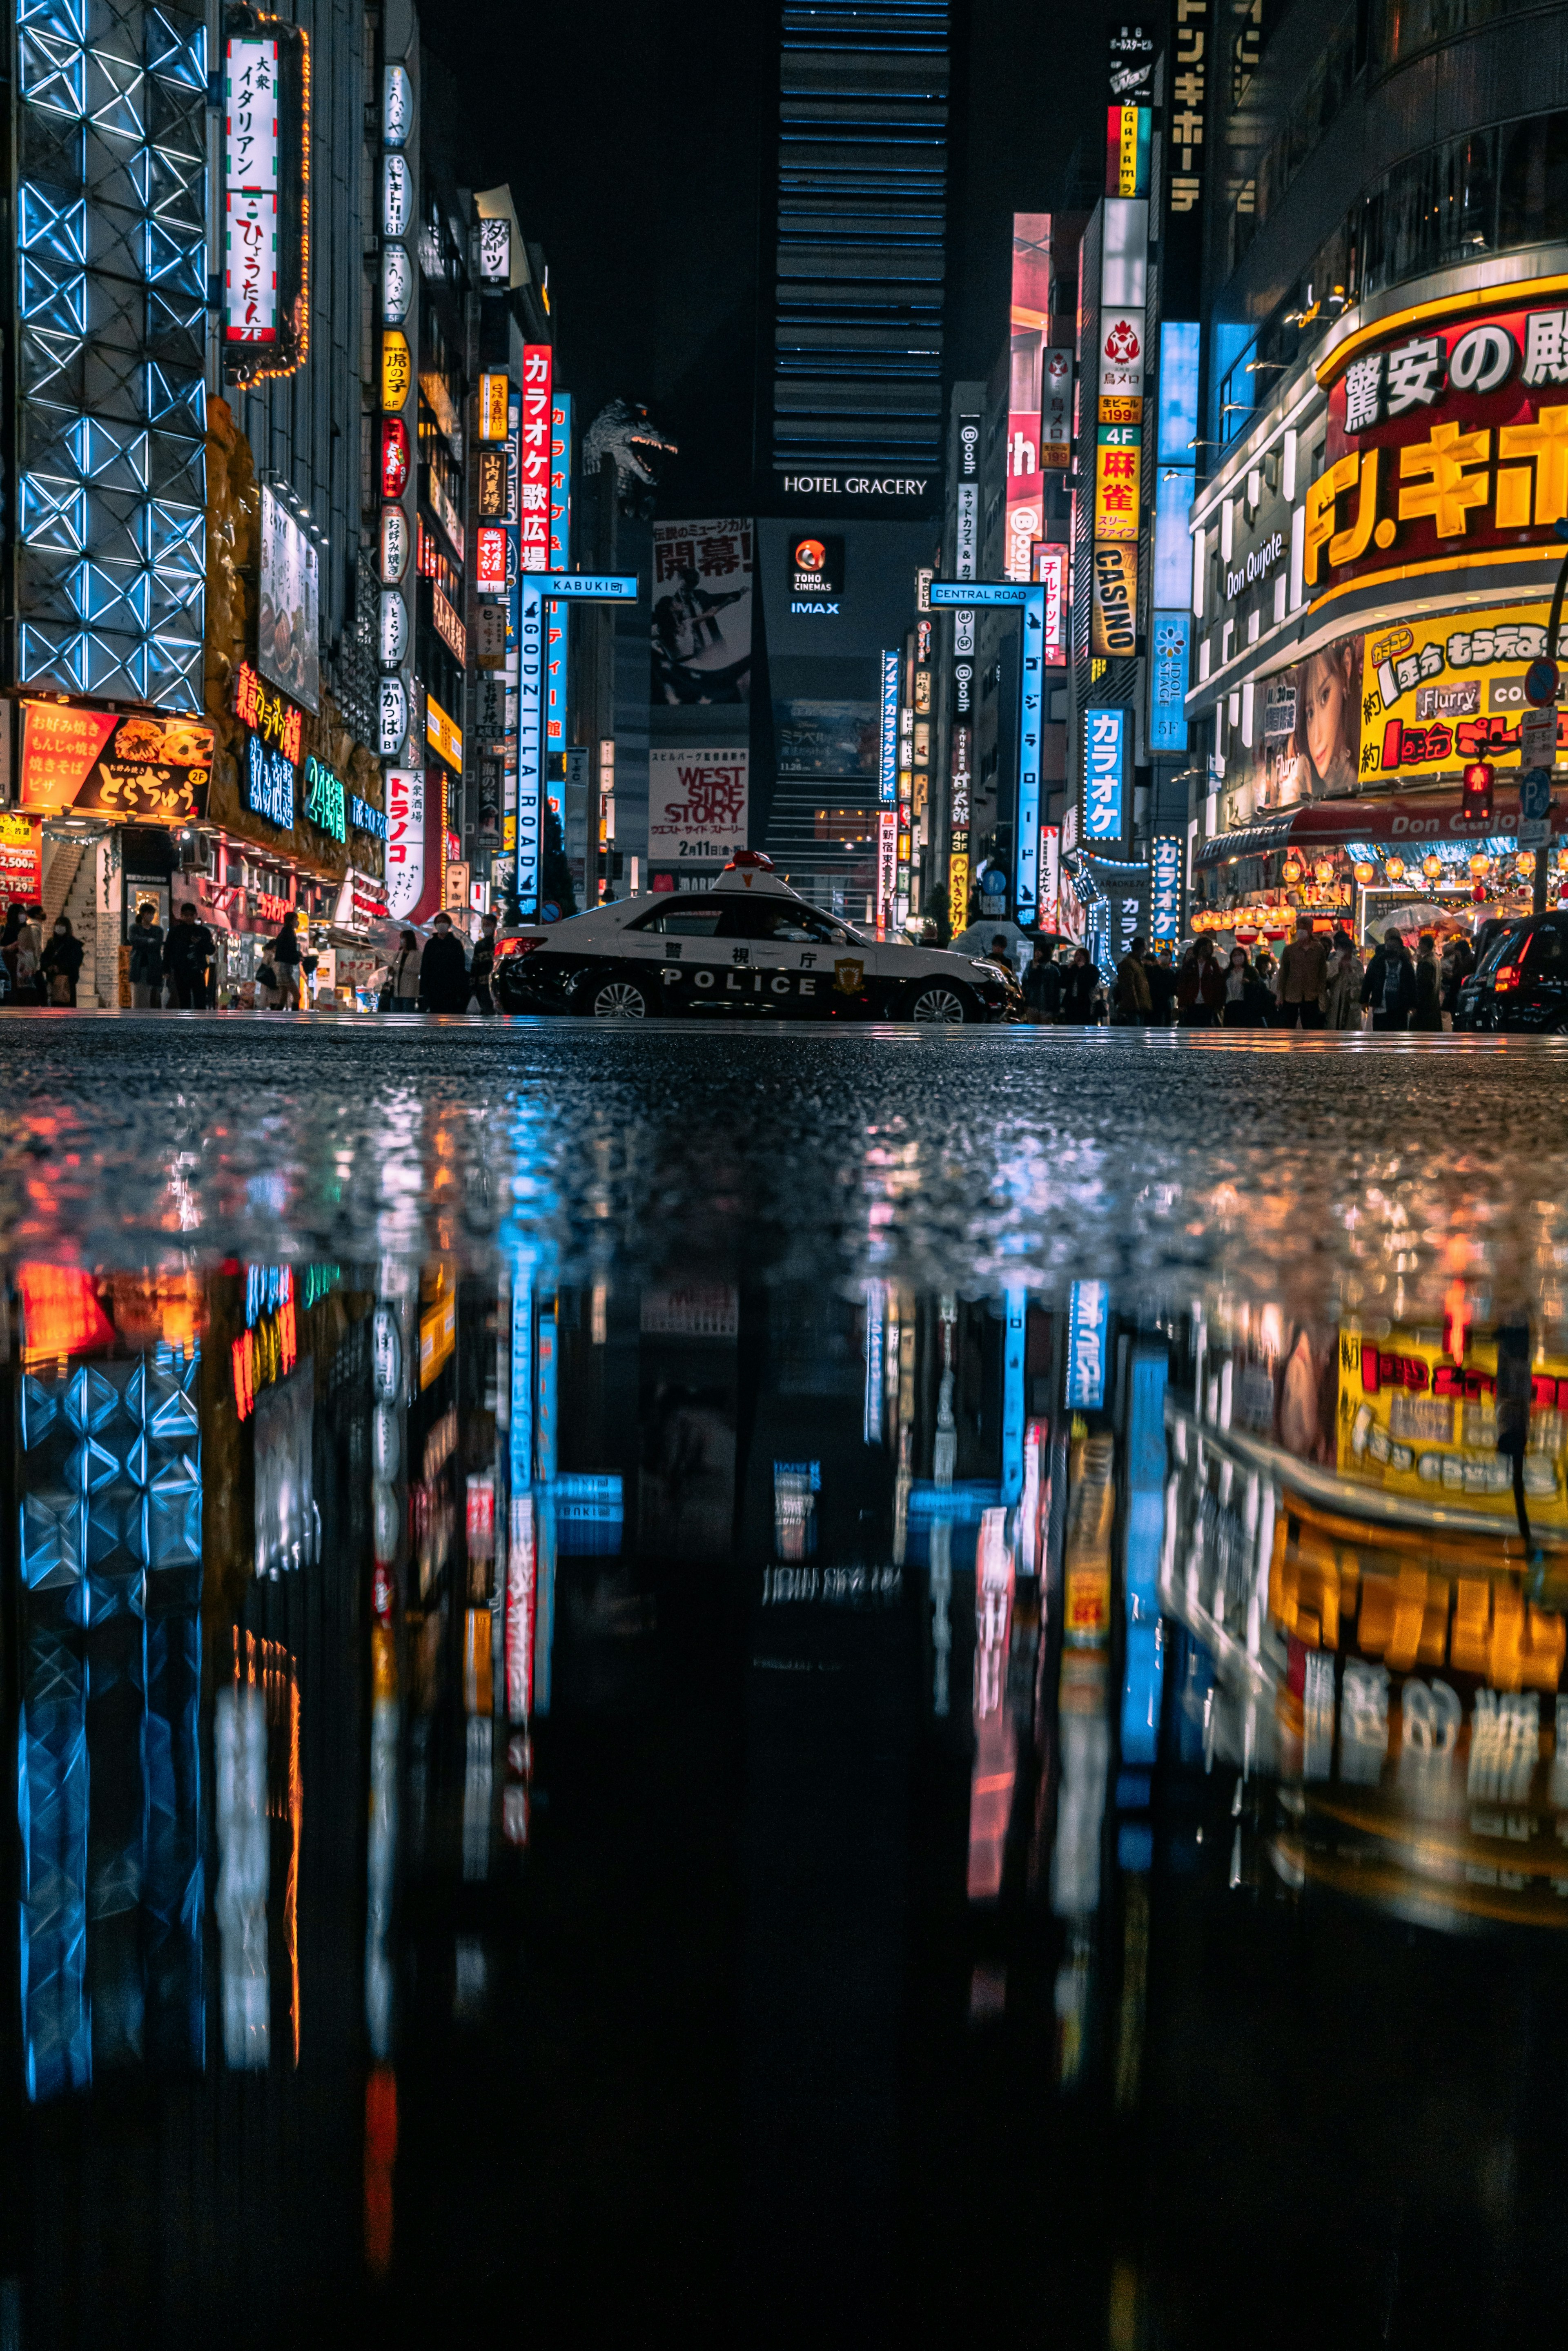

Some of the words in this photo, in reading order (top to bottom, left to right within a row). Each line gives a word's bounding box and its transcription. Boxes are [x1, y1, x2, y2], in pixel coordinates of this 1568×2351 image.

[255, 56, 271, 91] 大衆
[237, 66, 256, 176] イタリアン
[1120, 111, 1134, 178] Garam
[385, 223, 404, 234] 6F
[486, 223, 504, 271] ダーツ
[236, 218, 264, 325] ひょうたん
[240, 328, 263, 341] 7F
[385, 353, 408, 393] 虎の子
[1103, 373, 1139, 385] 鳥メロ
[1051, 397, 1064, 439] 鳥メロ
[1102, 399, 1138, 408] 生ビール
[960, 425, 978, 475] Booth
[1106, 428, 1133, 445] 4F
[523, 354, 548, 571] カラオケ歌広場
[483, 454, 501, 507] 山内農場
[784, 477, 842, 493] HOTEL
[845, 478, 927, 495] GRACERY
[1102, 451, 1135, 512] 麻雀
[962, 490, 973, 546] ネットカフェ
[1098, 517, 1128, 525] スリー
[388, 519, 400, 576] お好み焼き
[1097, 528, 1137, 539] ファイブ
[795, 574, 822, 583] TOHO
[1227, 568, 1245, 601] Don
[1247, 532, 1282, 583] Quijote
[485, 583, 497, 592] 4F
[794, 583, 832, 591] CINEMAS
[936, 589, 991, 599] CENTRAL
[995, 591, 1027, 600] ROAD
[1095, 549, 1134, 650] CASINO
[791, 603, 840, 614] IMAX
[390, 607, 399, 657] とらそば
[955, 663, 973, 712] Booth
[1160, 662, 1169, 706] STAGE
[1171, 662, 1181, 699] IDOL
[382, 691, 400, 735] かっぱ
[521, 623, 539, 777] GODZILLA
[1421, 688, 1477, 717] Flurry
[32, 717, 100, 737] お好み焼き
[1158, 721, 1178, 735] 5F
[32, 737, 99, 757] もんじゃ焼き
[383, 741, 397, 750] B1
[883, 703, 897, 796] カラオケランド
[1022, 657, 1041, 860] ゴジラロード
[29, 756, 85, 776] 焼きそば
[110, 765, 145, 774] お好み焼き
[192, 772, 205, 781] 2F
[677, 766, 746, 788] WEST
[1090, 714, 1120, 834] カラオケ
[29, 778, 56, 793] ピザ
[98, 763, 194, 810] とらぢゅう
[411, 772, 423, 823] 大衆酒場
[688, 784, 744, 805] SIDE
[951, 772, 971, 825] 甘太郎
[389, 778, 409, 864] トラノコ
[664, 800, 745, 824] STORY
[1392, 816, 1440, 834] Don
[520, 796, 537, 867] ROAD
[952, 832, 969, 841] 4F
[952, 842, 969, 851] 3F
[403, 864, 419, 899] やきとり
[1040, 868, 1051, 893] 九十九
[1155, 842, 1176, 935] カラオケ
[953, 875, 965, 926] やきとり
[665, 942, 817, 968] 警視庁
[1154, 940, 1174, 953] B1
[340, 960, 374, 971] トラノコ
[664, 968, 816, 996] POLICE
